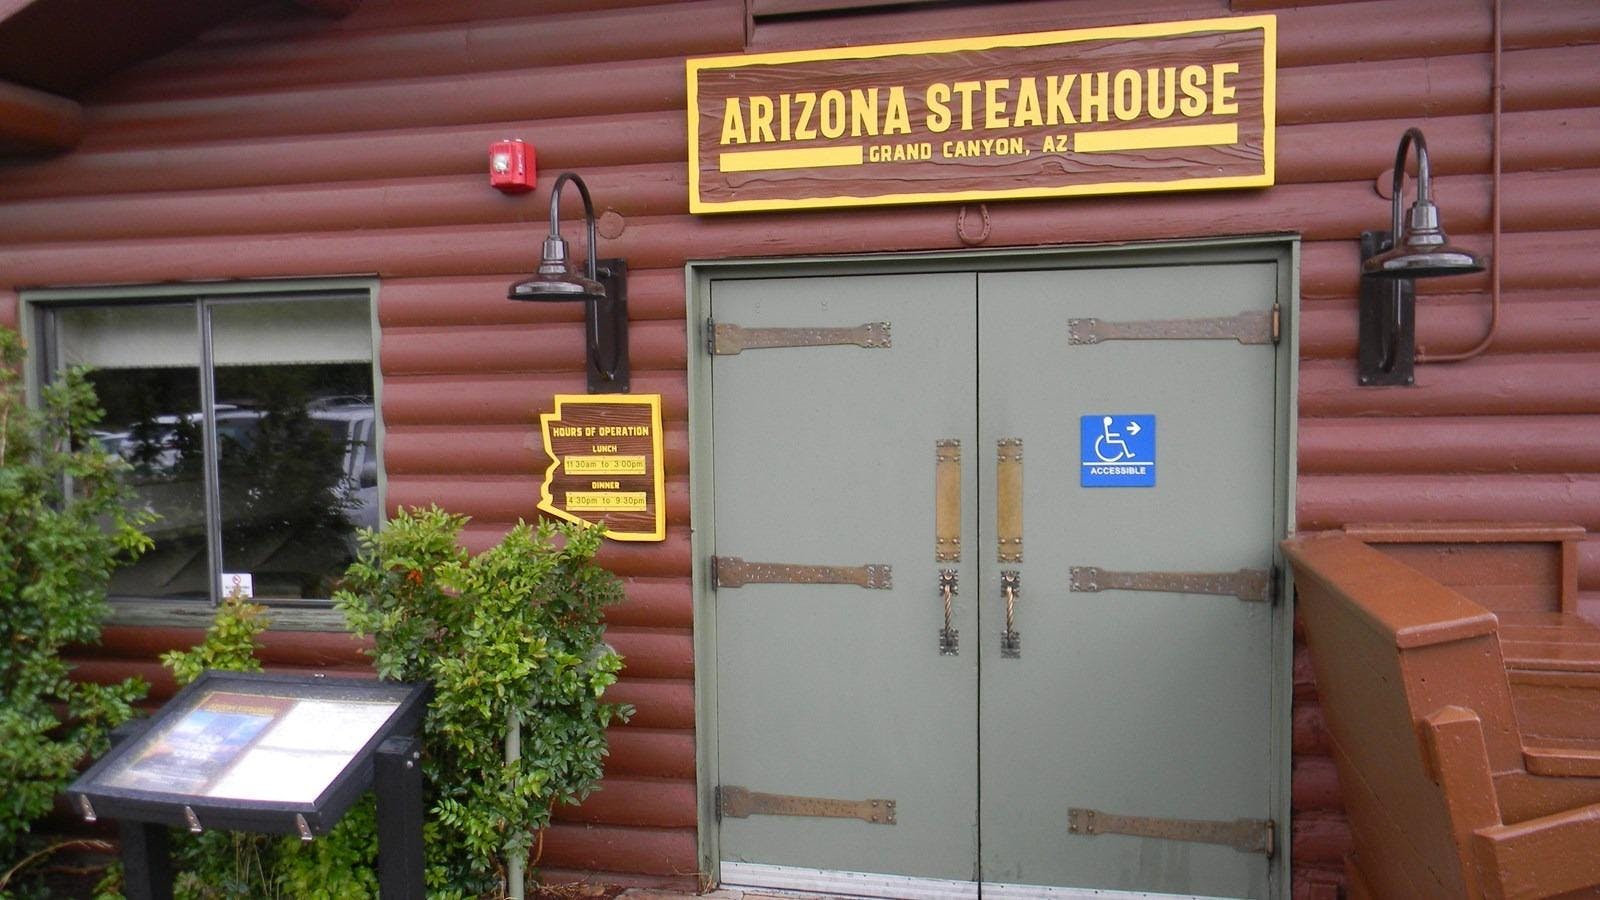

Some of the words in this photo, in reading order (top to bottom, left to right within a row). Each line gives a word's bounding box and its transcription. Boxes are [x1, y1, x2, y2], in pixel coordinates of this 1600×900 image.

[720, 85, 911, 145] ARIZONA
[926, 62, 1239, 133] STEAKHOUSE
[869, 142, 932, 163] GRAND
[942, 137, 1030, 160] CANYON,
[1042, 135, 1068, 153] AZ
[553, 427, 582, 437] HOURS
[585, 427, 596, 437] OF
[599, 426, 649, 437] OPERATION
[592, 445, 617, 453] LUNCH
[566, 460, 597, 468] 1130am
[601, 460, 609, 468] to
[614, 460, 643, 469] 300pm
[1090, 466, 1146, 475] ACCESSIBLE
[592, 481, 620, 489] DINNER
[568, 496, 597, 505] 430pm
[602, 496, 610, 505] to
[616, 496, 645, 505] 930pm
